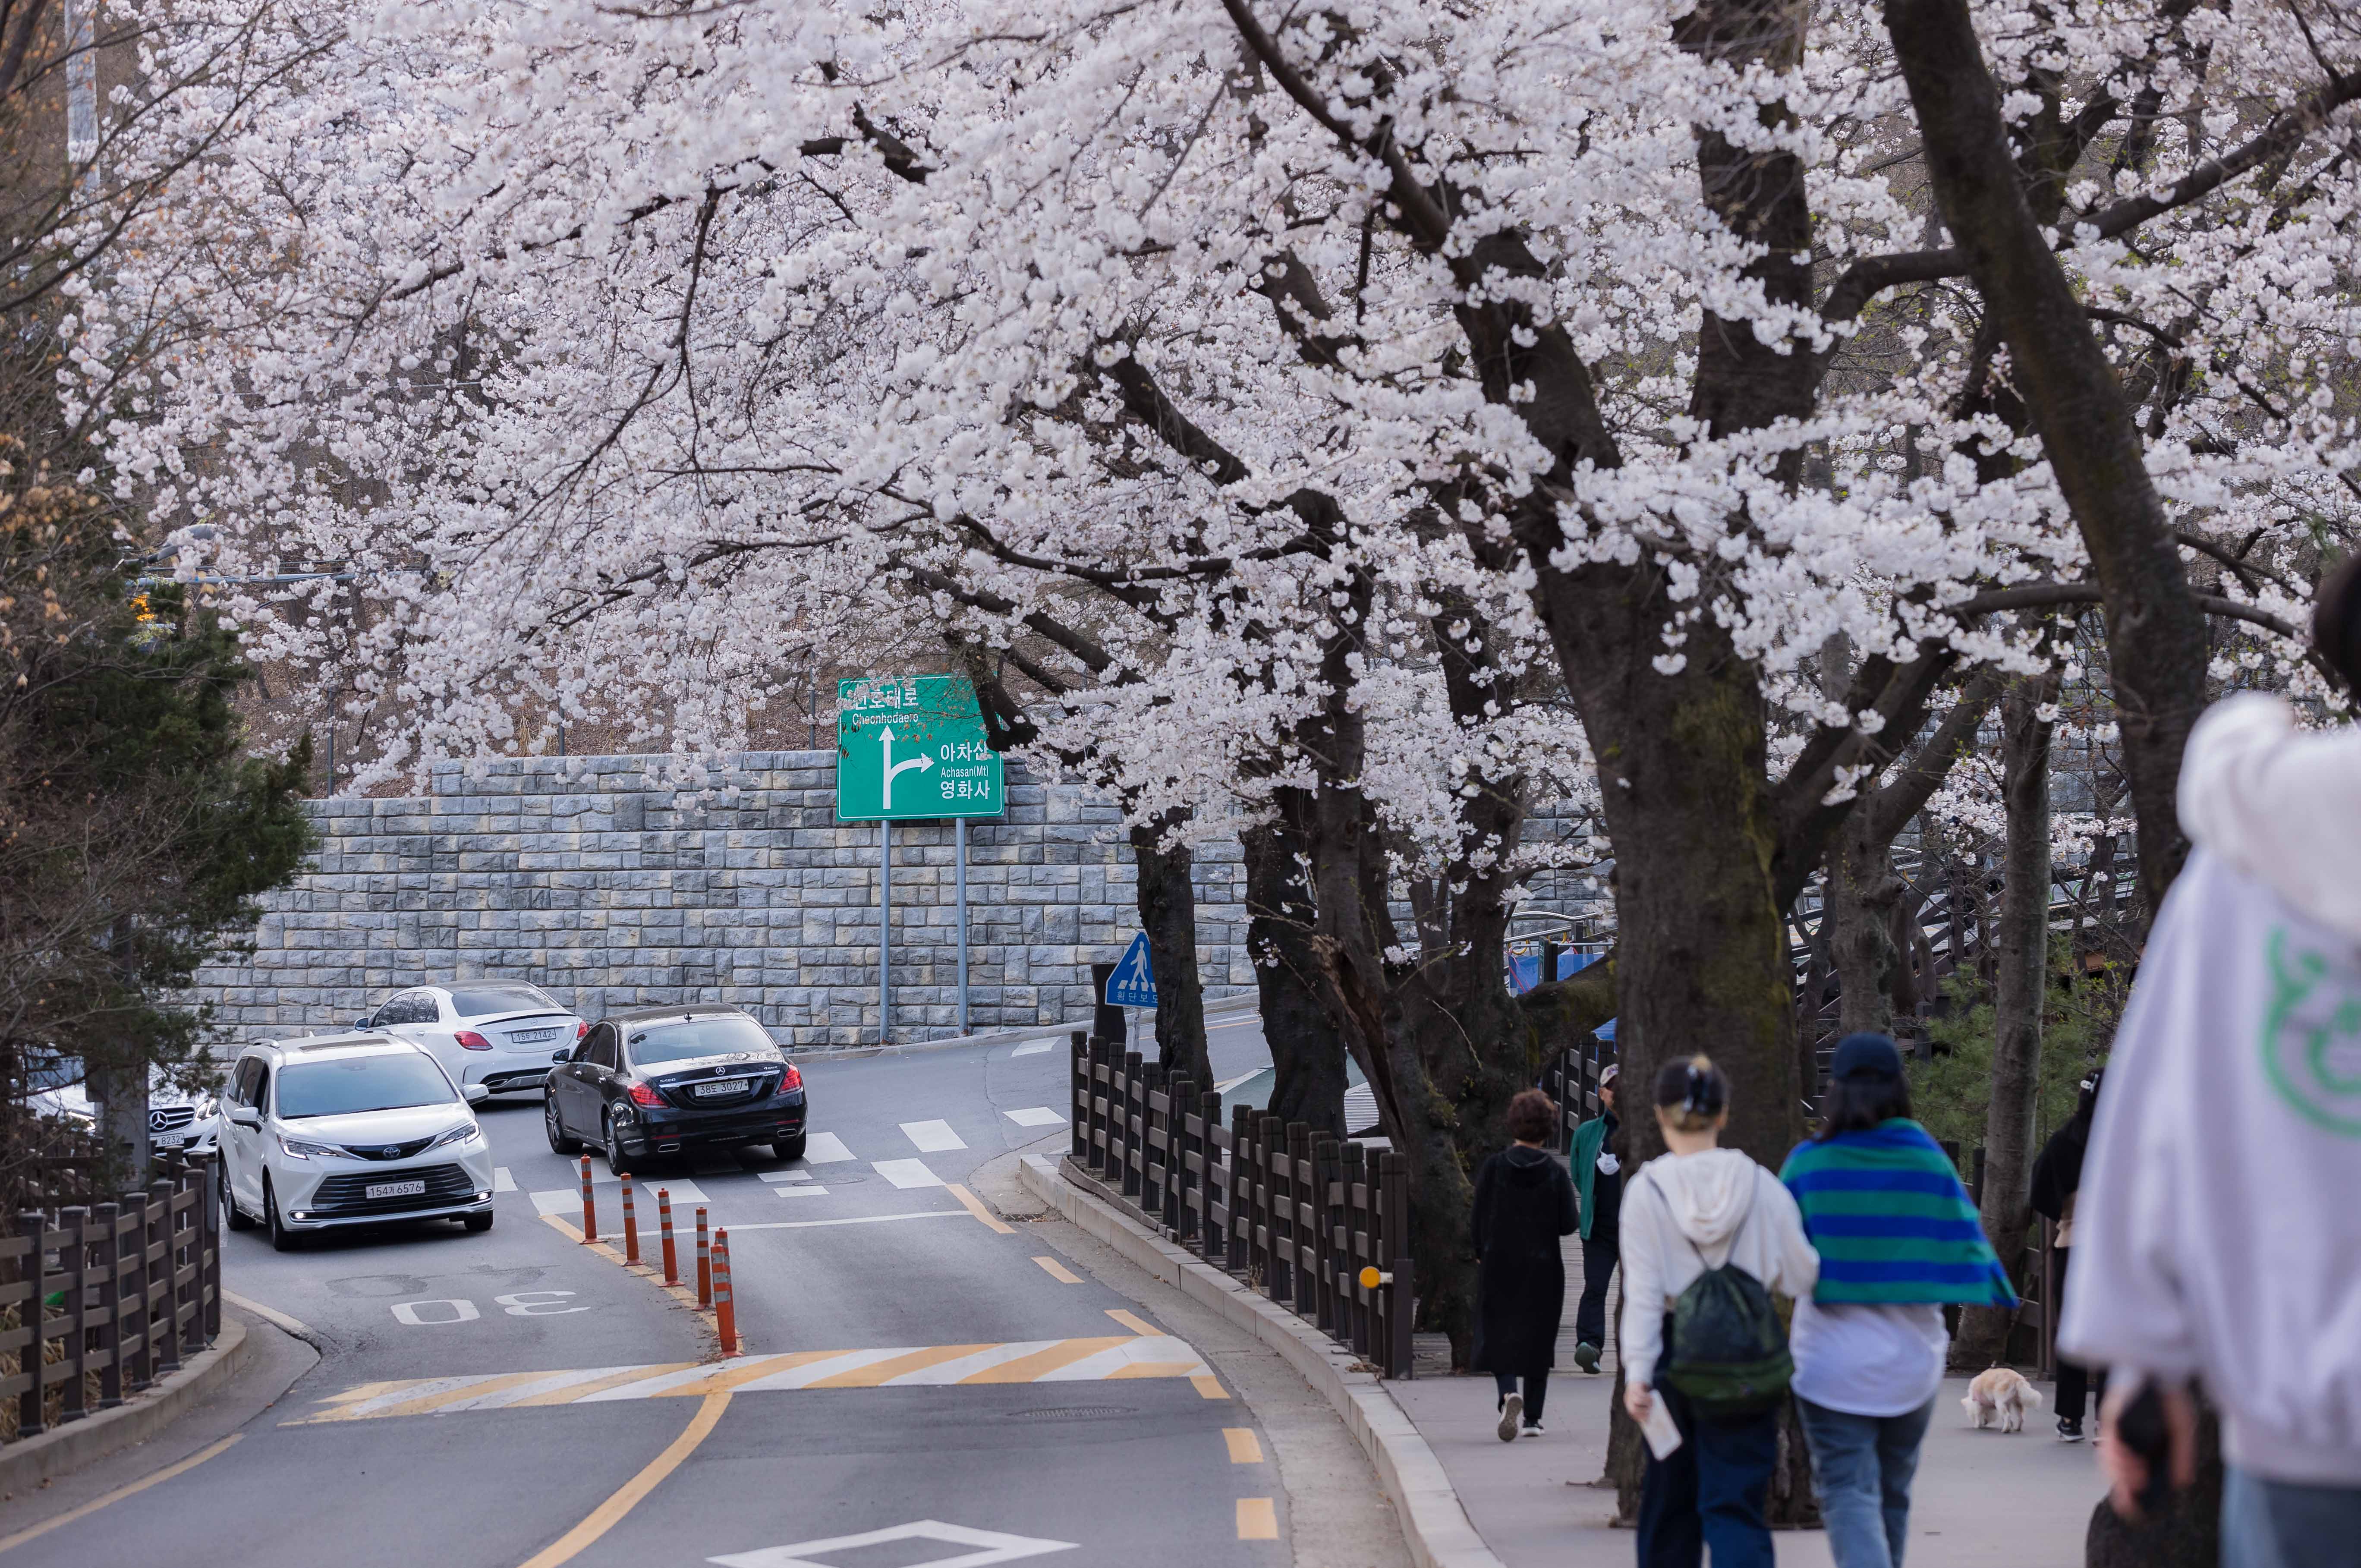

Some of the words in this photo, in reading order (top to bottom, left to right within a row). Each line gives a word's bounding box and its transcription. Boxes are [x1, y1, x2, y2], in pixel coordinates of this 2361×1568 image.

[852, 712, 918, 725] Cheonhodaero
[940, 741, 989, 762] 아차산
[940, 765, 988, 778] Achasan(Mt)
[940, 780, 990, 800] 영화사
[1117, 991, 1158, 1003] 횡단보도
[533, 1030, 552, 1039] 2142
[700, 1085, 717, 1094] 38도
[721, 1081, 743, 1092] 3027
[162, 1135, 180, 1145] 8232
[370, 1186, 394, 1196] 154가
[397, 1183, 421, 1194] 6576
